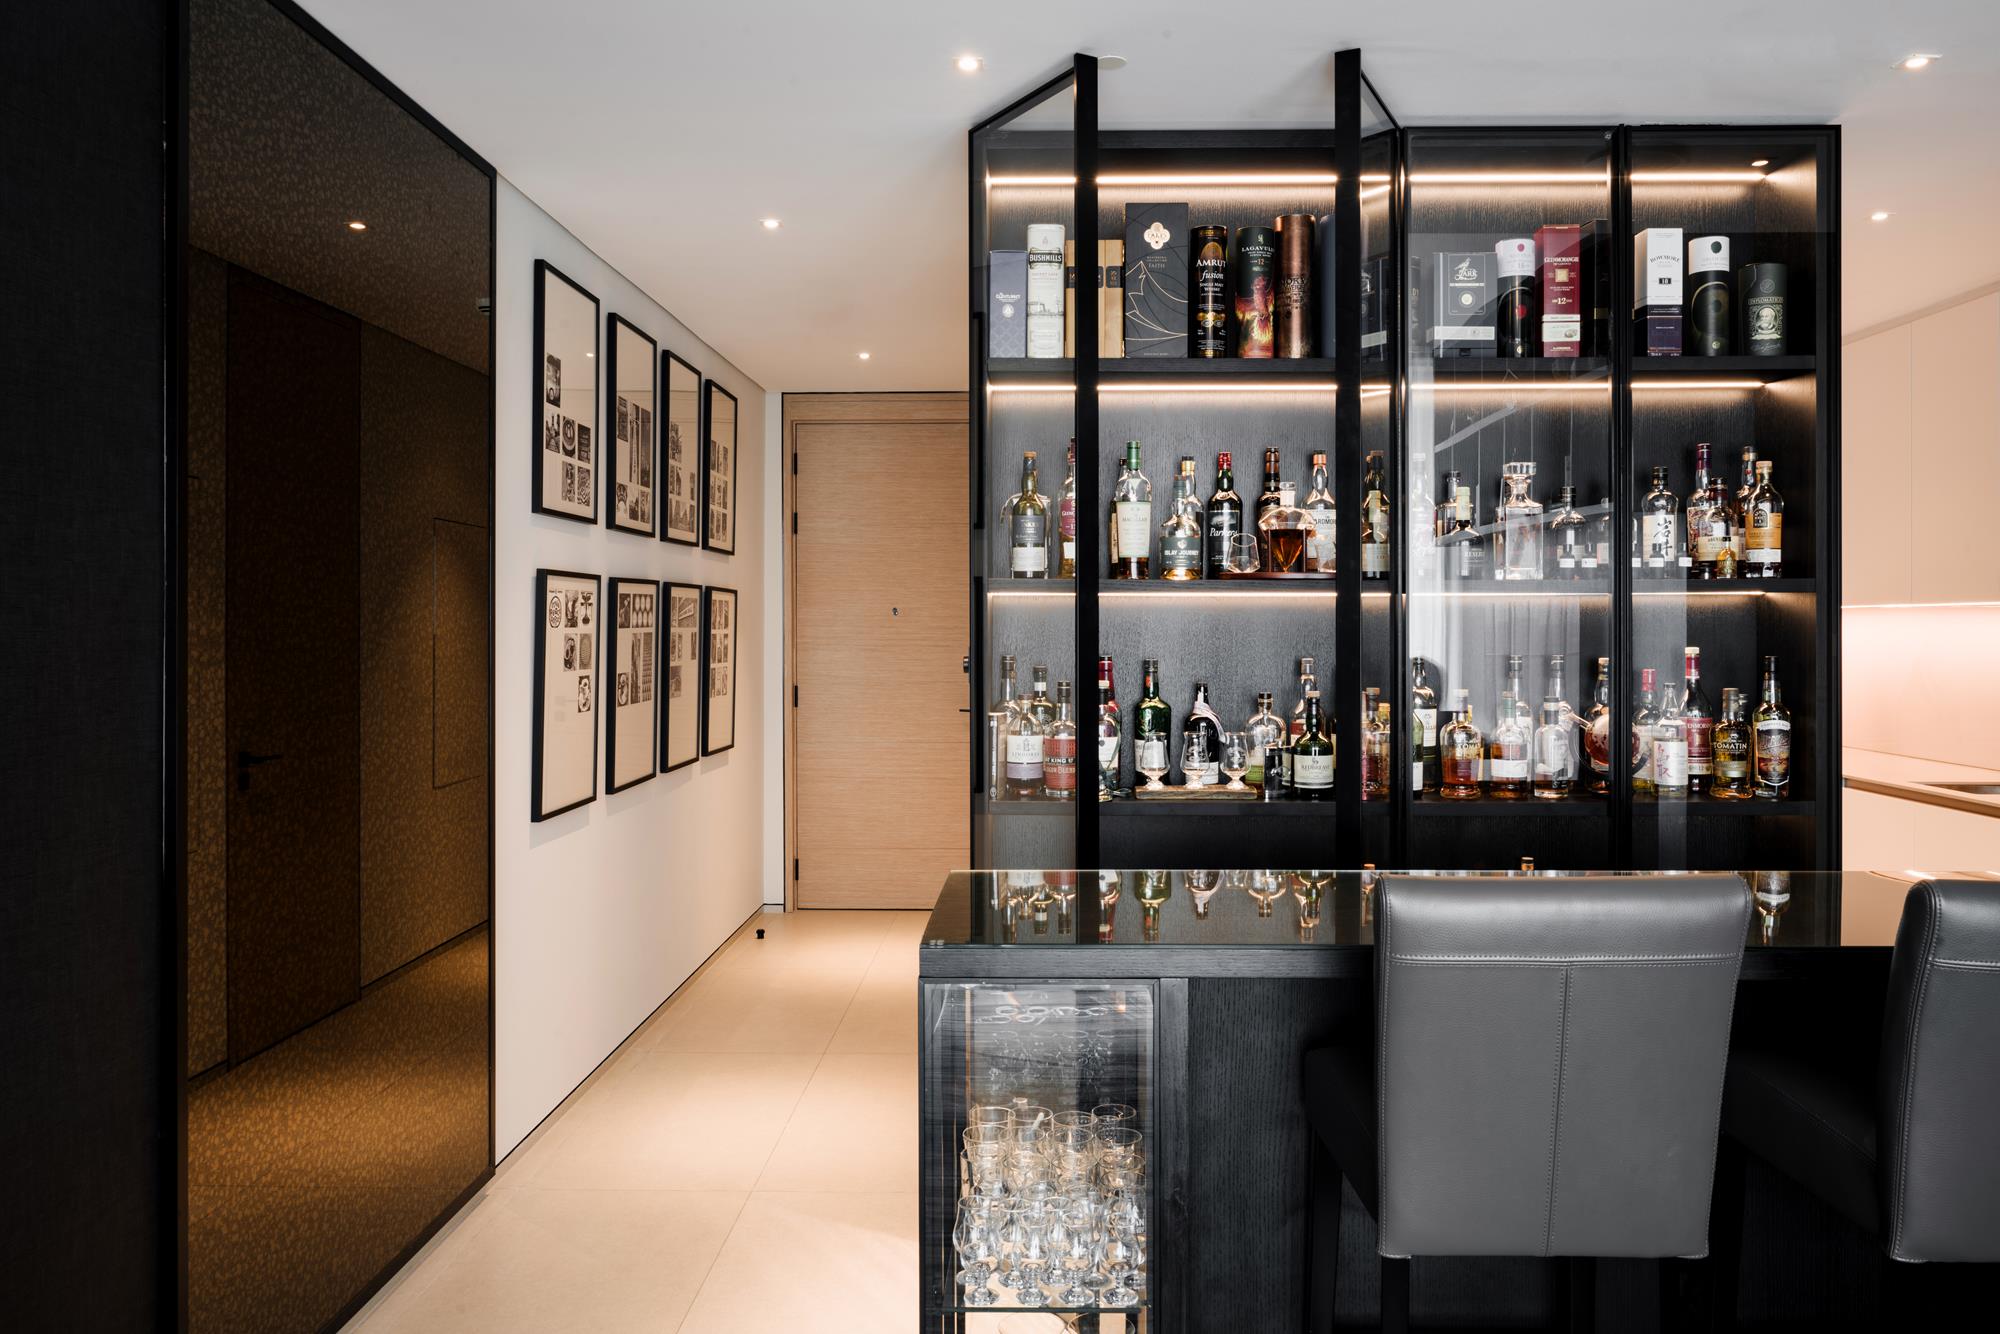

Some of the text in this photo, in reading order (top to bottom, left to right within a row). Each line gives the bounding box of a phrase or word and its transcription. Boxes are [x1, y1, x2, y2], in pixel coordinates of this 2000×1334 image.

[1029, 253, 1062, 262] BUSHMILLS
[1196, 258, 1226, 268] AMRUT
[1200, 269, 1225, 282] fusion
[1557, 297, 1567, 305] 12
[1712, 742, 1748, 750] TOMATIN
